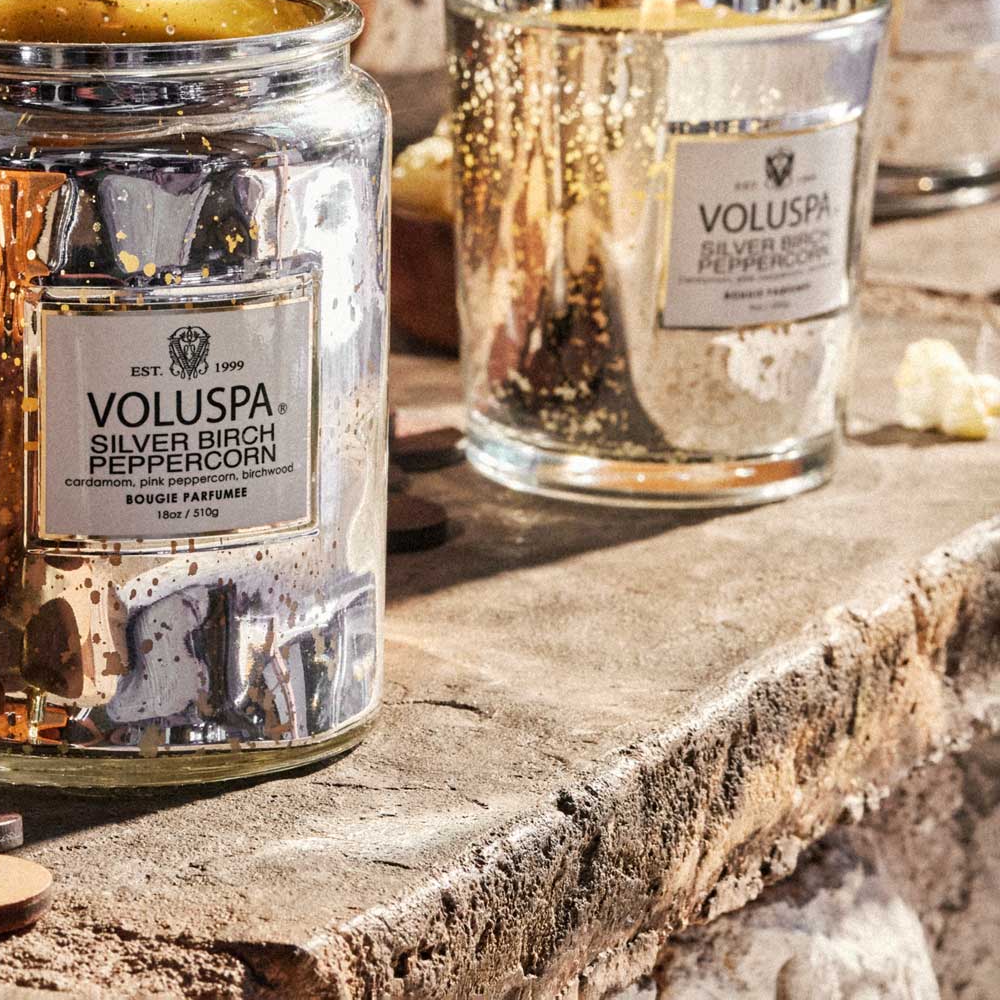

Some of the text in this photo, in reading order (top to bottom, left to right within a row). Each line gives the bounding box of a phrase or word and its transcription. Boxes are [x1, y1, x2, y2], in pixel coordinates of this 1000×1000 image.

[699, 192, 830, 233] VOLUSPA
[130, 360, 245, 377] EST. 1999
[90, 423, 275, 454] SILVER BIRCH
[89, 444, 277, 475] PEPPERCORN
[65, 463, 294, 489] cardamom, pink peppercorn, birchwood
[126, 487, 248, 505] BOUGIE PARFUMEE
[157, 510, 182, 520] 18oz
[193, 507, 219, 519] 510g
